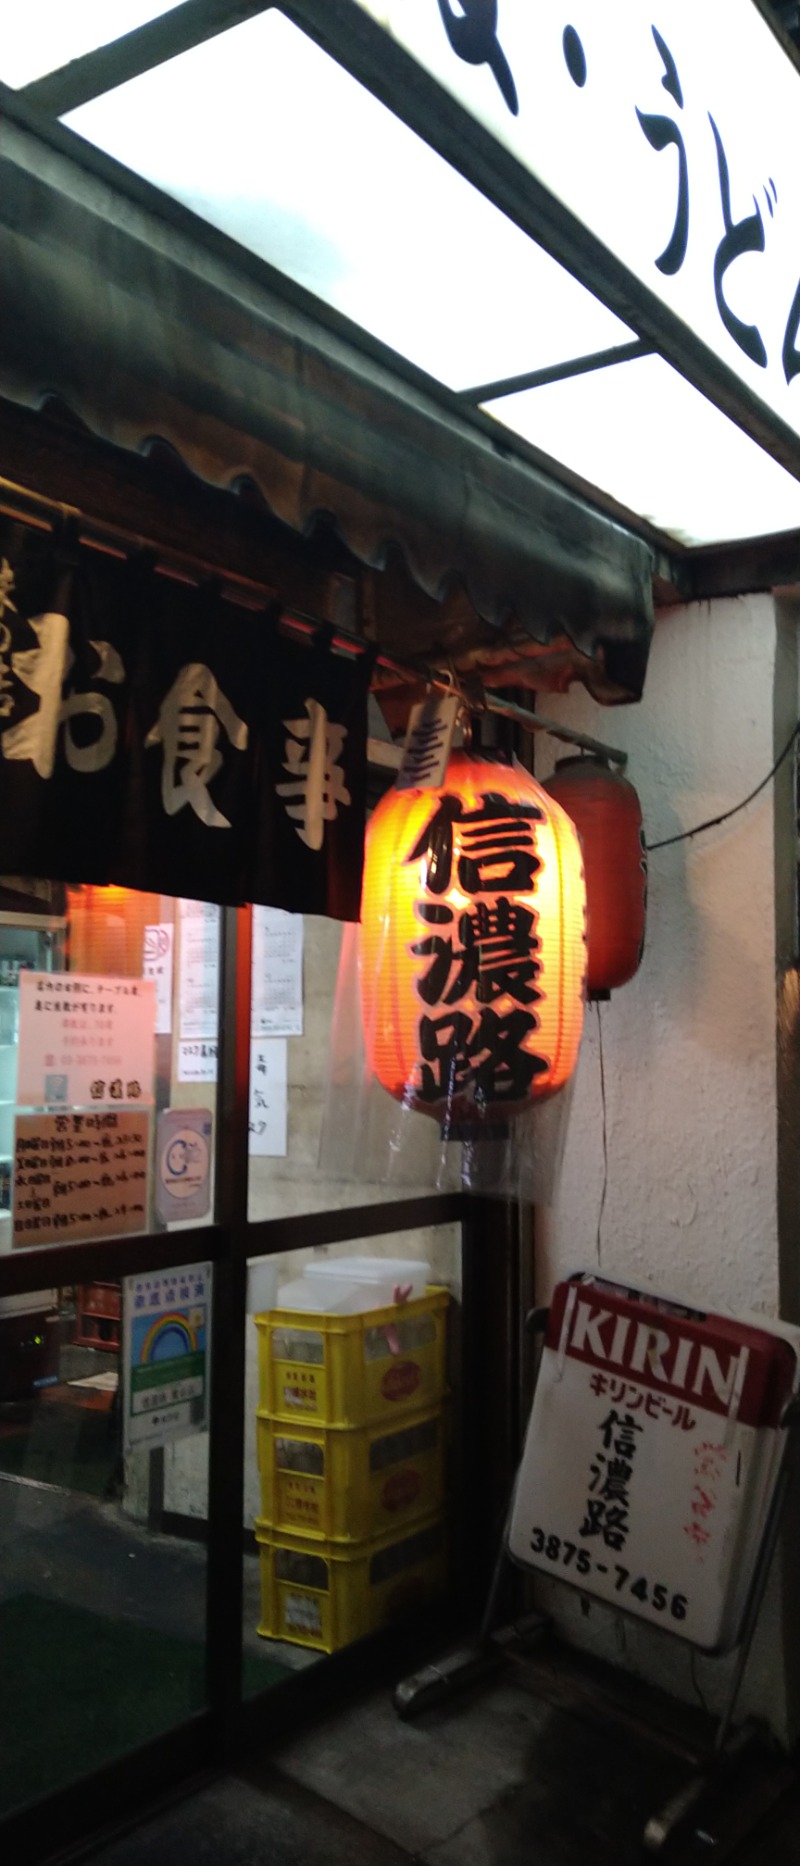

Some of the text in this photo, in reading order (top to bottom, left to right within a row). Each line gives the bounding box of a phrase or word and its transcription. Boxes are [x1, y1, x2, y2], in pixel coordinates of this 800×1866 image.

[2, 613, 351, 850] お食事
[402, 793, 551, 1101] 信濃路
[570, 1301, 739, 1406] KIRIN
[590, 1373, 696, 1431] キリンビール
[579, 1410, 643, 1552] 信濃路
[530, 1527, 688, 1620] 3875-7456
